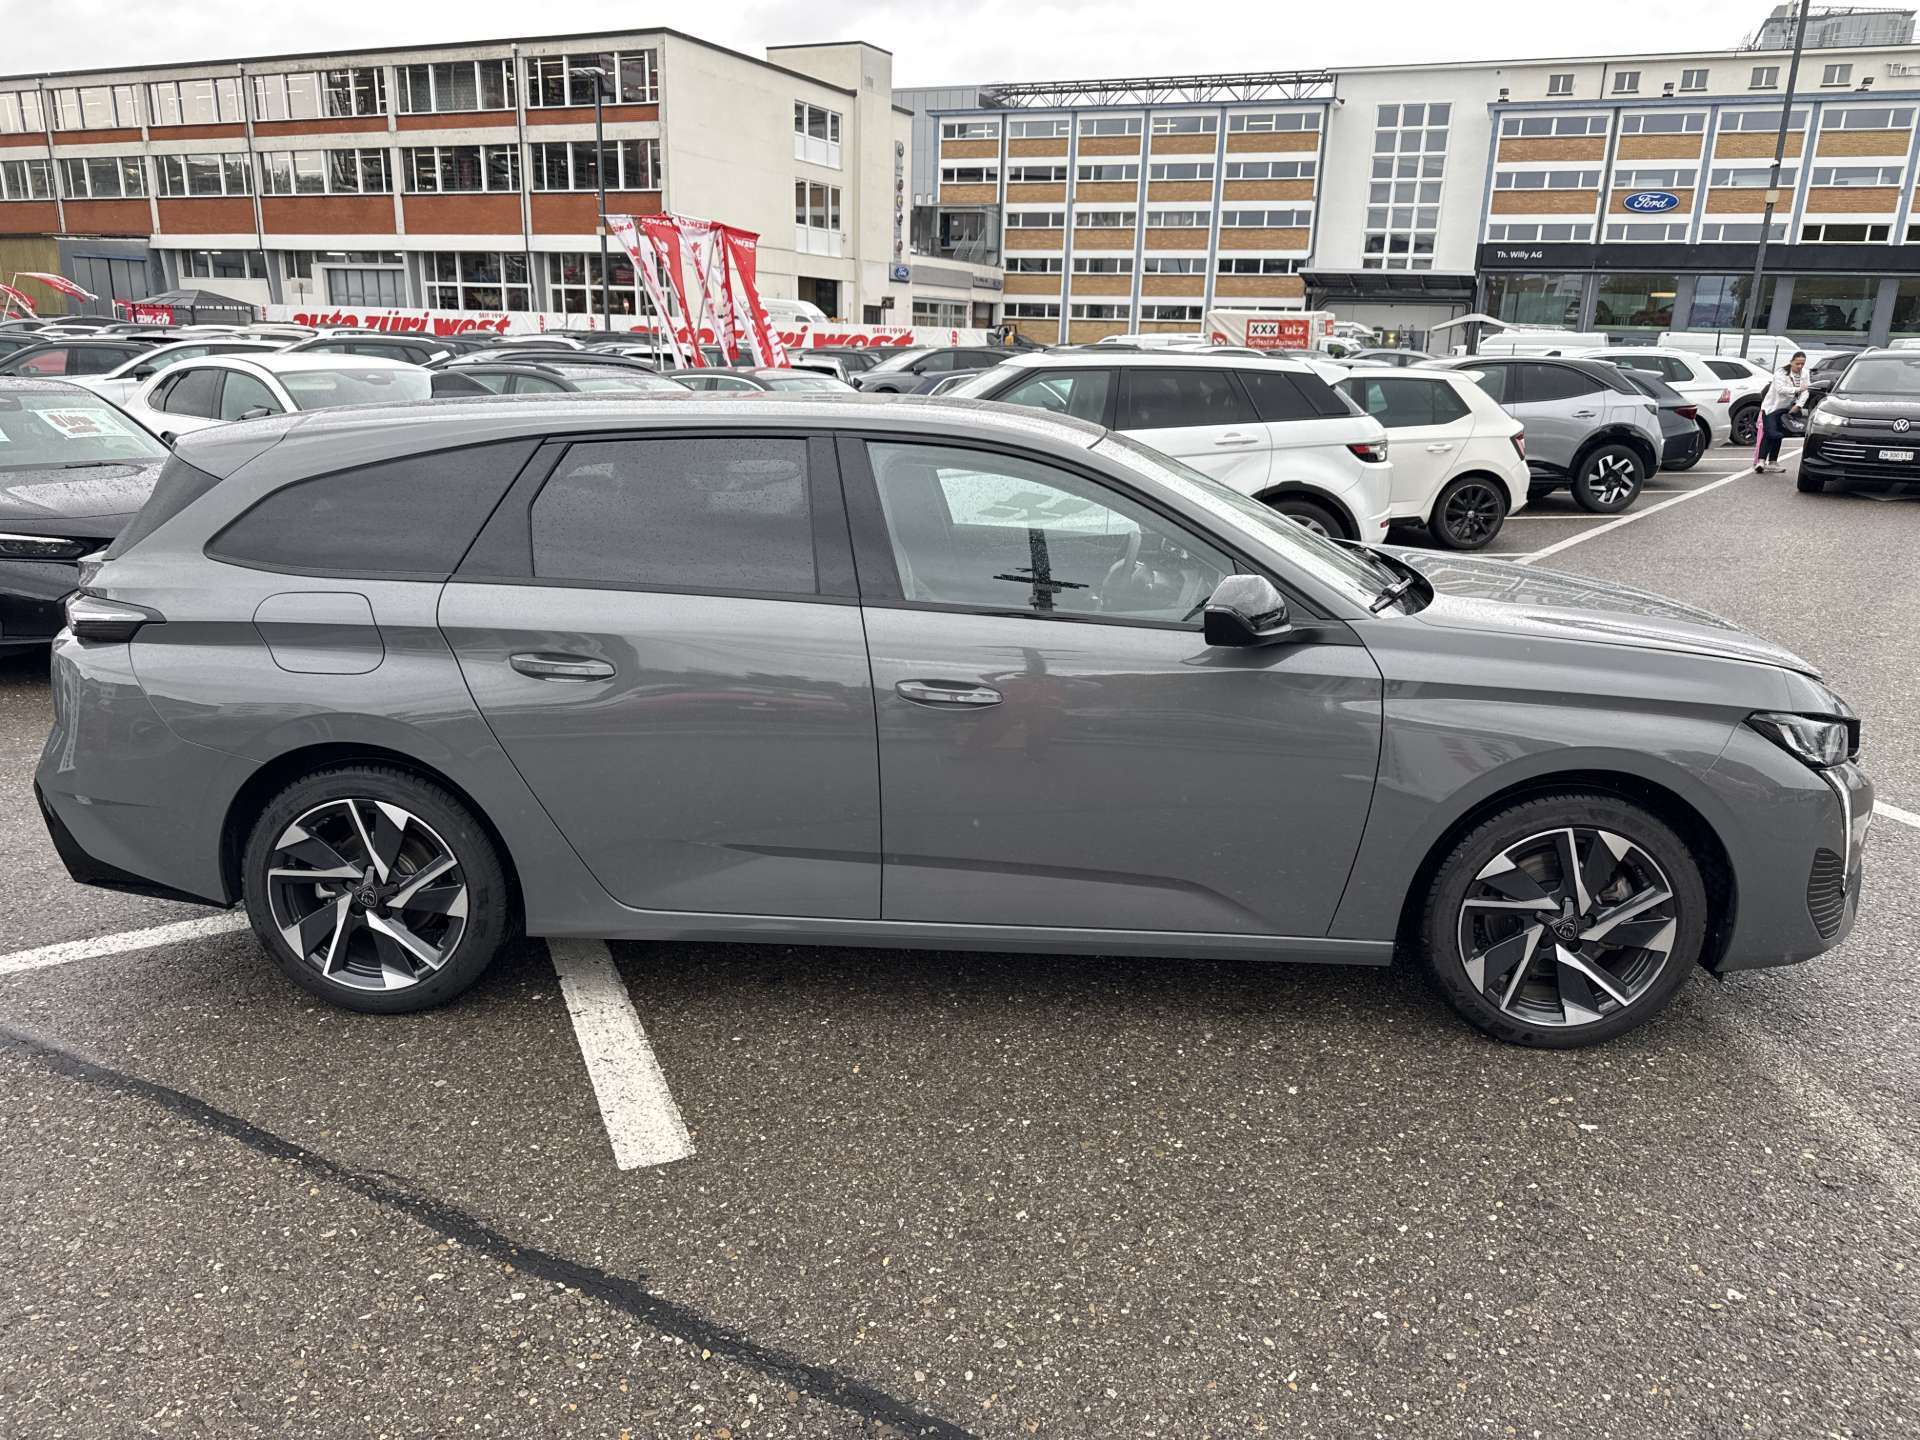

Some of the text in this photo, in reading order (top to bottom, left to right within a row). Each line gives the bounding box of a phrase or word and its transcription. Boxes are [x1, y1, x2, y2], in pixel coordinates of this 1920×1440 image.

[1634, 194, 1668, 209] Ford
[1496, 250, 1543, 261] Th. Willy AG
[293, 309, 512, 337] auto züri west
